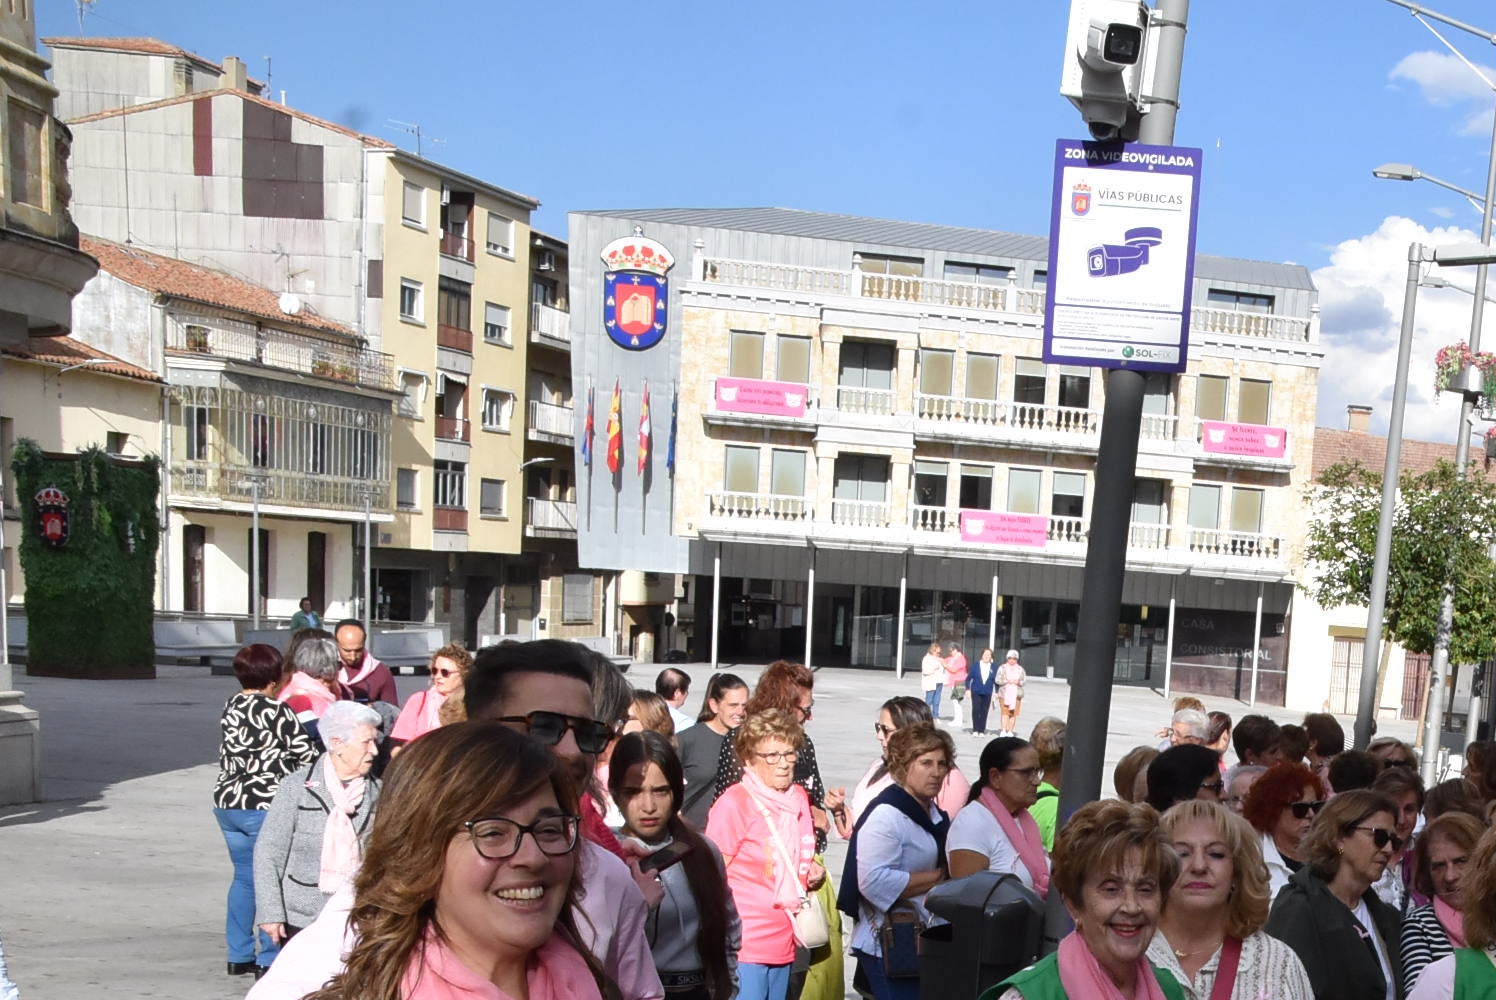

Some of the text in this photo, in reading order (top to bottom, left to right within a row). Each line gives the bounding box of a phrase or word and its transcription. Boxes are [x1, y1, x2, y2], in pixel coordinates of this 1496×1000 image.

[1064, 148, 1194, 168] ZONA VIDEOVIGILADA
[1098, 187, 1183, 205] VÍAS PÚBLICAS
[1182, 617, 1214, 630] CASA
[1180, 643, 1272, 661] CONSISTORAL
